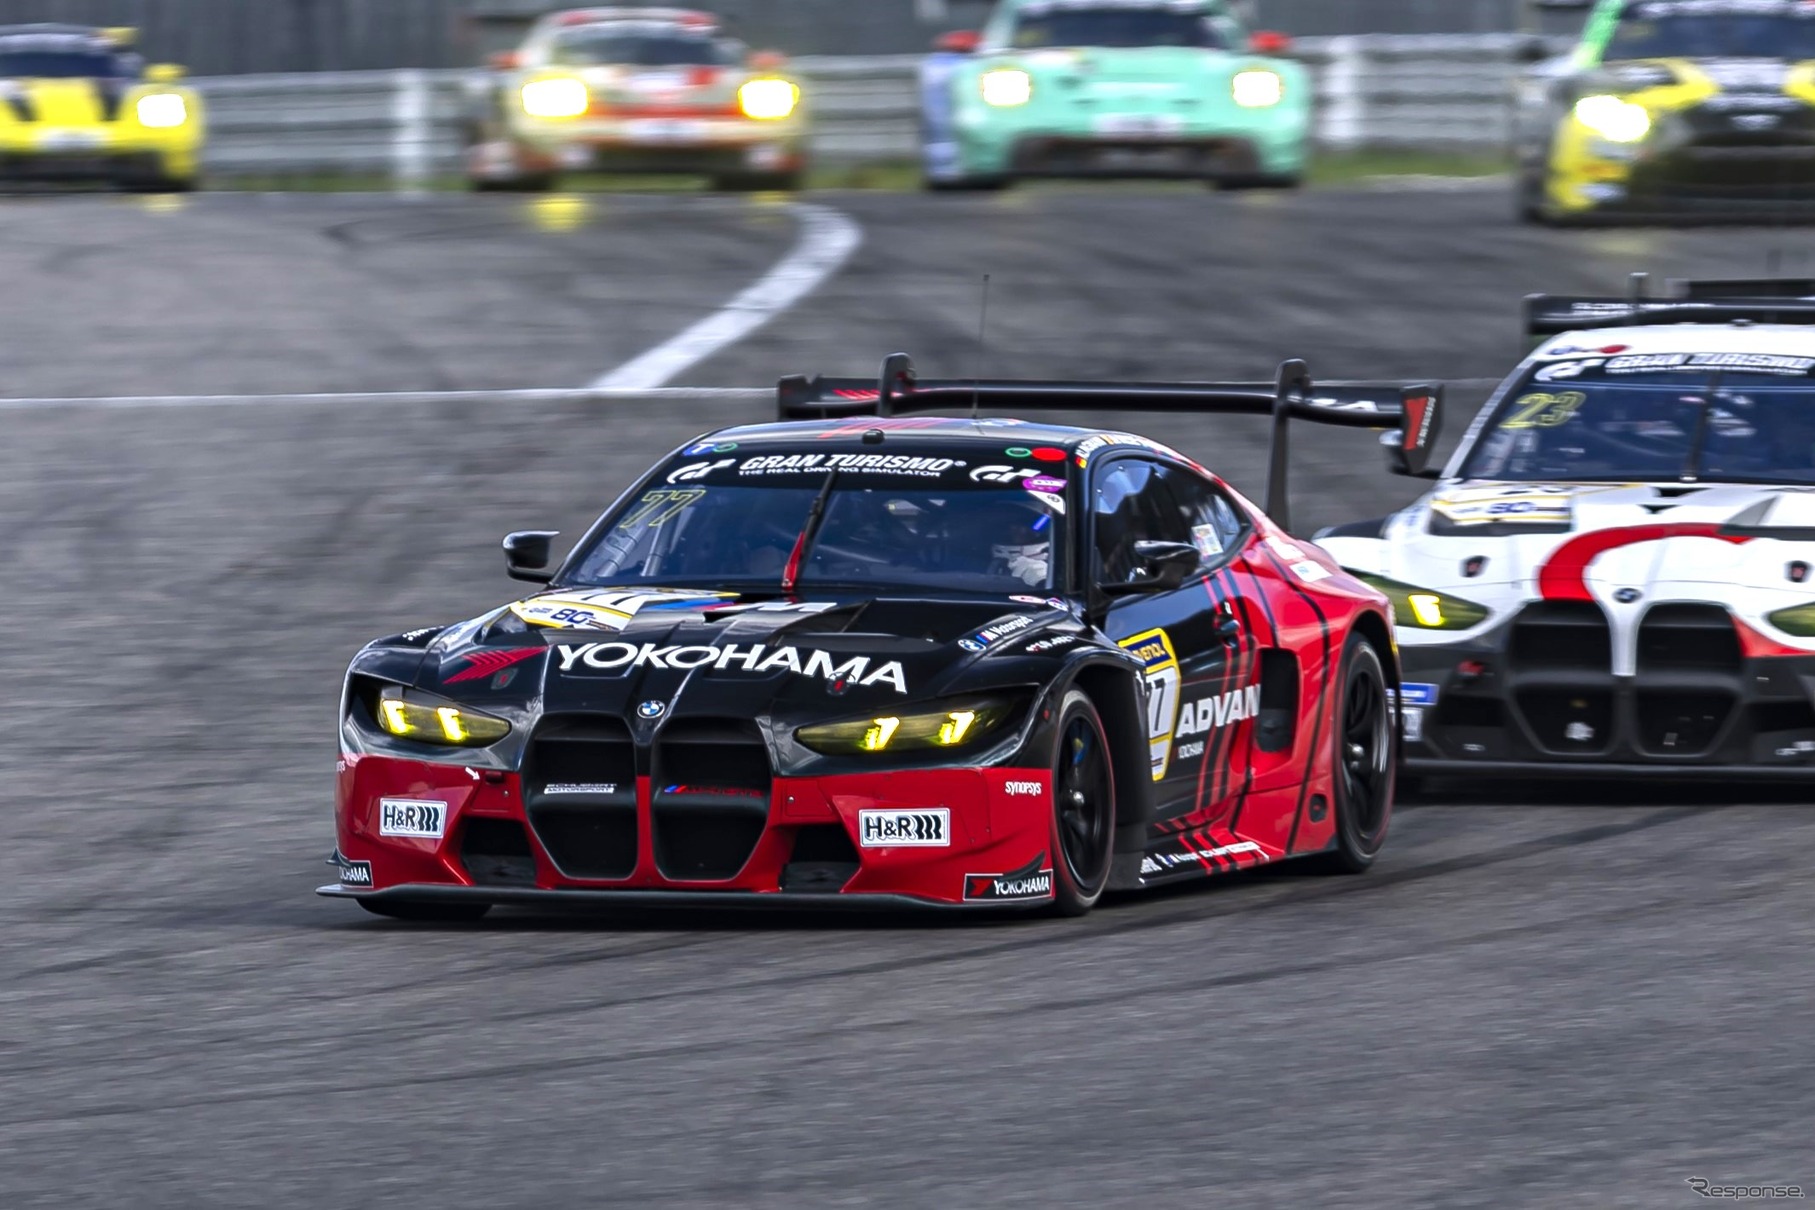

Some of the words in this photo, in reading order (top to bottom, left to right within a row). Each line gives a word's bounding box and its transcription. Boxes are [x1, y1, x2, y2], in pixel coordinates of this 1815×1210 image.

[1499, 391, 1587, 429] 23
[740, 454, 826, 470] GRAN
[862, 468, 941, 477] SIMULATOR
[620, 489, 707, 529] 77
[557, 642, 908, 695] YOKOHAMA
[1175, 683, 1262, 739] ADVAN
[864, 814, 914, 840] H&R
[993, 875, 1050, 895] YOKOHAMA
